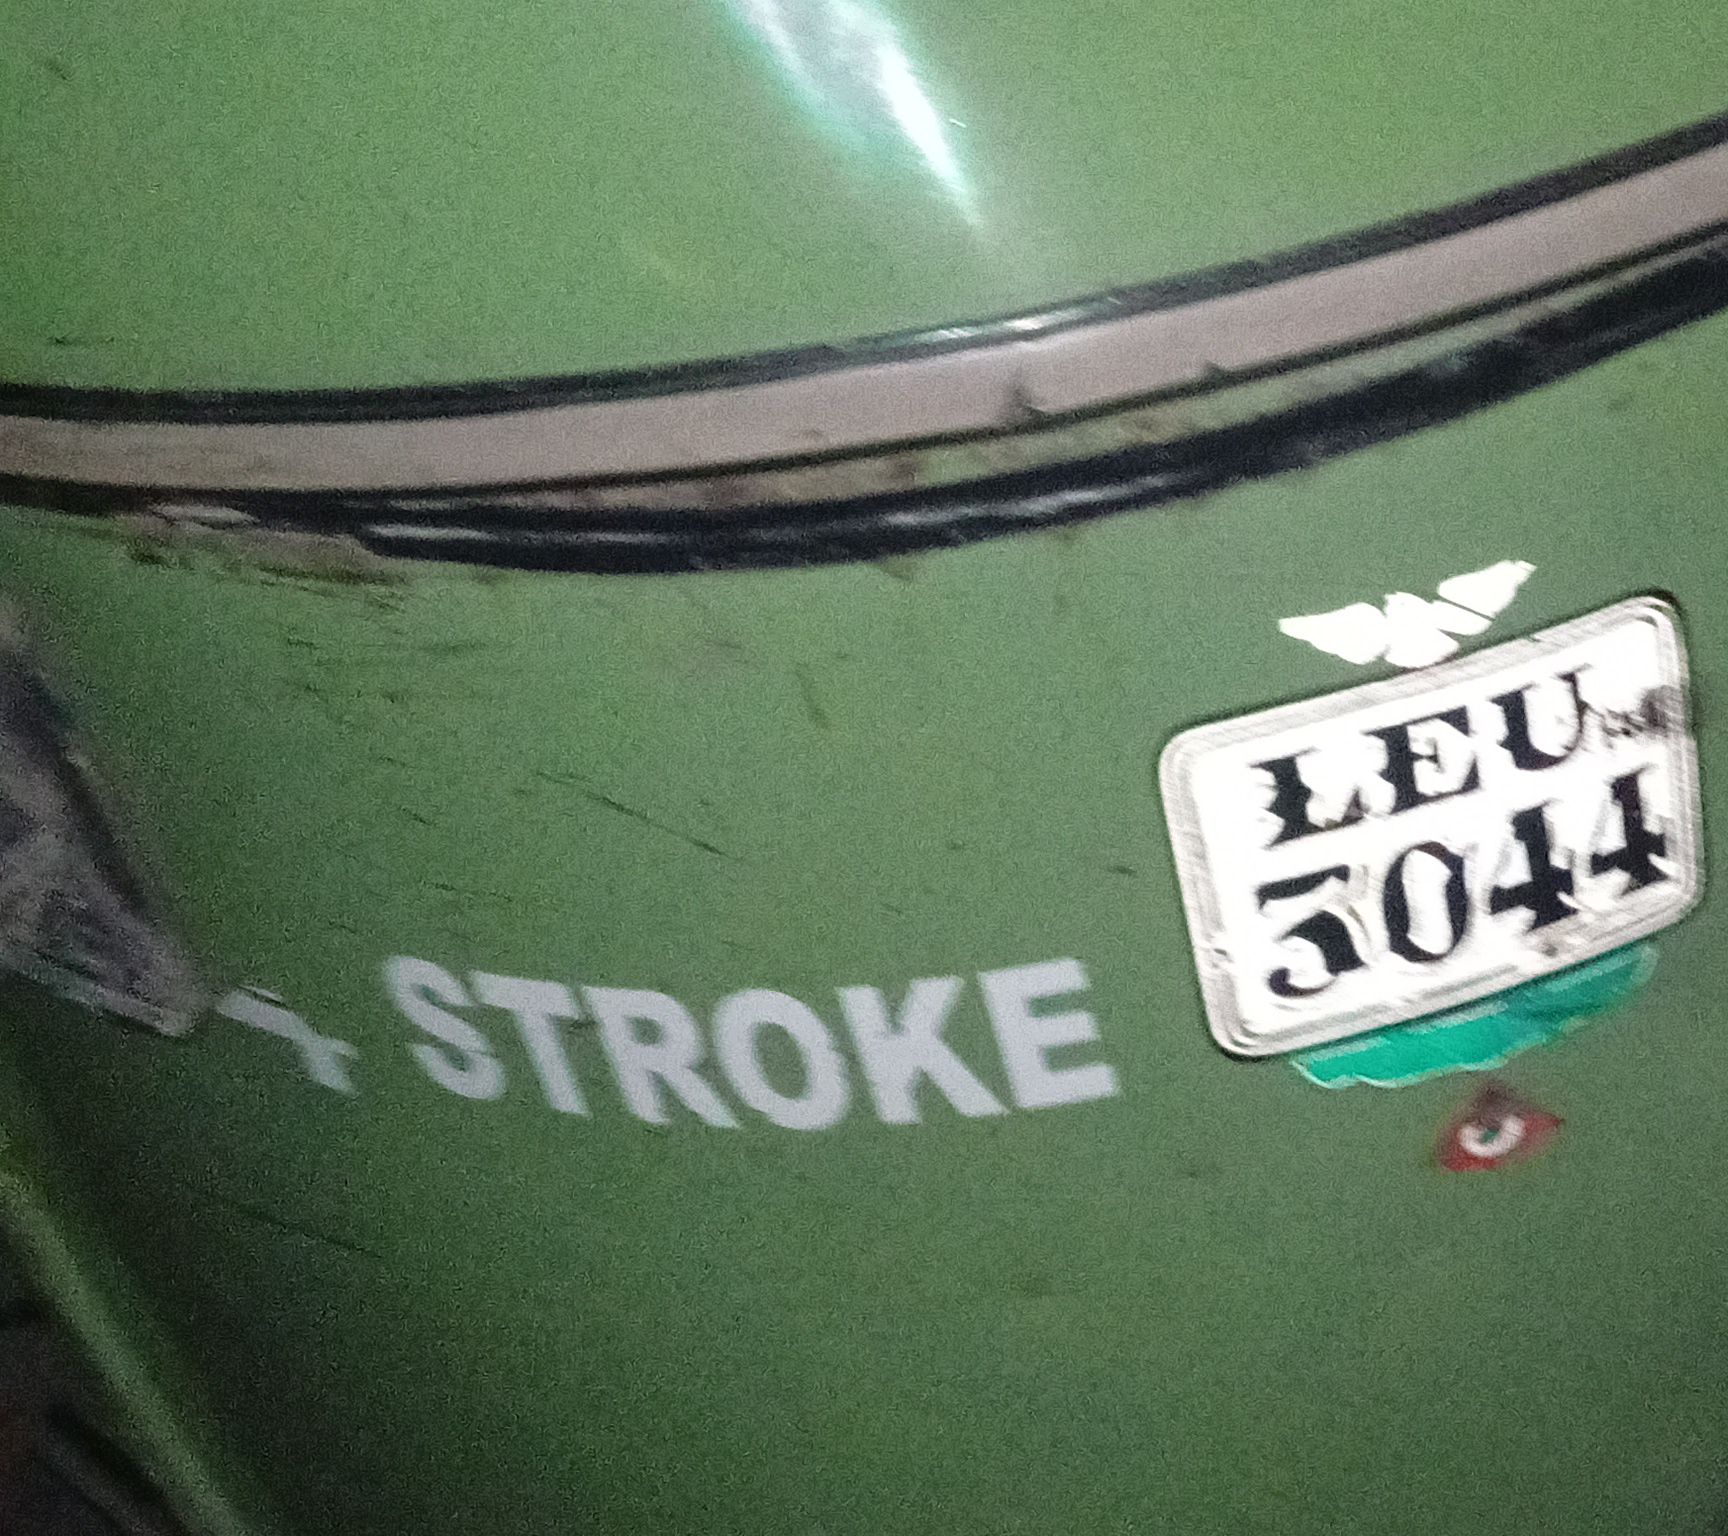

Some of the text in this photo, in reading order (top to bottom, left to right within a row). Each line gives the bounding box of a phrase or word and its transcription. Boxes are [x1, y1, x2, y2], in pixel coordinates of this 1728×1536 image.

[1250, 663, 1595, 848] LEU
[1254, 763, 1672, 999] 5044
[382, 953, 1121, 1132] STROKE
